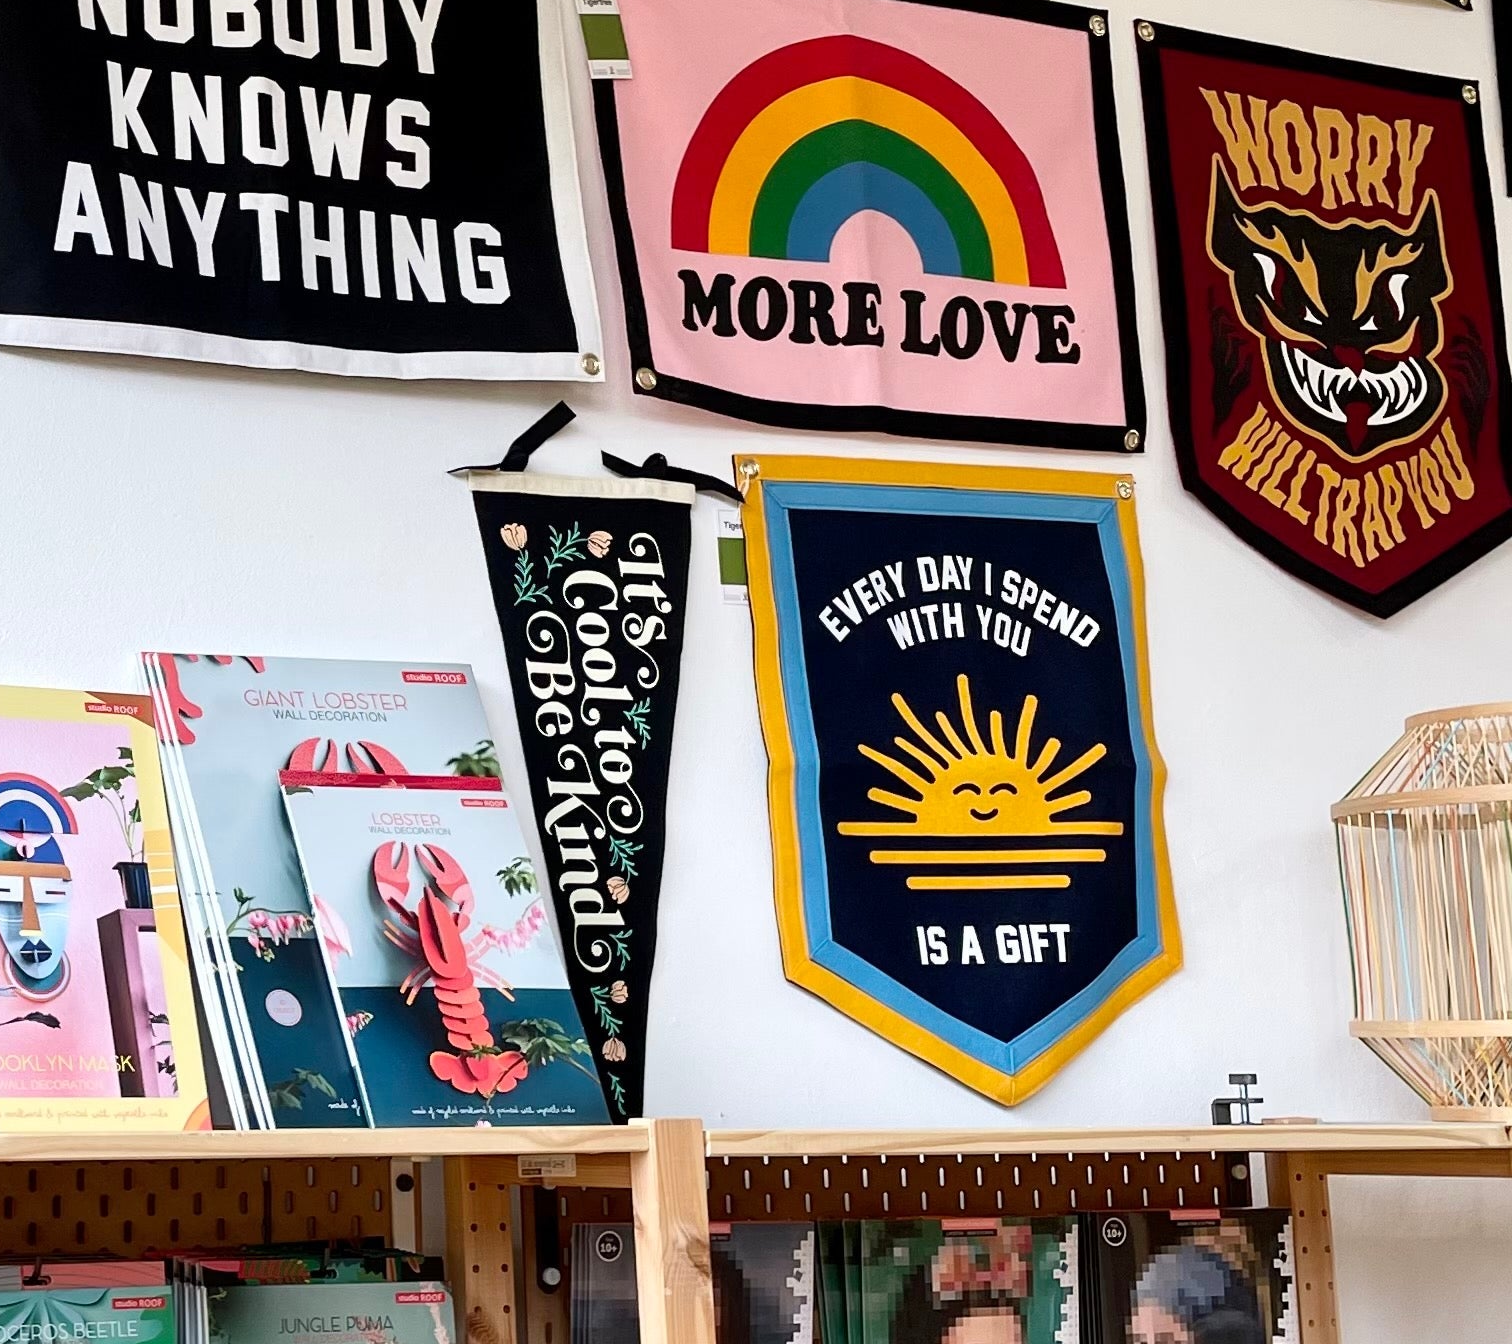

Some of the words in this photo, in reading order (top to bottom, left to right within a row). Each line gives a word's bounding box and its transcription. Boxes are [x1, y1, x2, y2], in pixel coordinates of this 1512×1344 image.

[106, 59, 431, 190] KNOWS
[1198, 87, 1434, 216] WORRY
[53, 160, 511, 304] ANYTHING
[677, 269, 884, 348] MORE
[899, 288, 1081, 365] LOVE
[1217, 401, 1311, 518] WILL
[1313, 459, 1407, 568] TRAP
[1399, 416, 1475, 530] YOU
[617, 532, 673, 690] It's
[818, 561, 906, 643] EVERY
[916, 555, 973, 592] DAY
[985, 562, 992, 596] I
[1000, 569, 1100, 647] SPEND
[887, 602, 965, 650] WITH
[976, 604, 1032, 657] YOU
[562, 569, 634, 727] Cool
[406, 673, 433, 682] studio
[434, 674, 464, 683] ROOF
[525, 610, 576, 737] Be
[88, 704, 113, 713] studio
[114, 705, 140, 715] ROOF
[244, 689, 305, 707] GIANT
[313, 692, 408, 711] LOBSTER
[272, 710, 307, 721] WALL
[308, 710, 388, 722] DECORATION
[593, 724, 644, 834] to
[371, 813, 441, 826] LOBSTER
[368, 826, 395, 834] WALL
[396, 826, 452, 836] DECORATION
[544, 743, 628, 974] Kind
[916, 925, 948, 966] IS
[960, 926, 985, 965] A
[995, 923, 1071, 965] GIFT
[79, 1055, 136, 1073] MASK
[31, 1079, 104, 1091] DECORATION
[1106, 1229, 1122, 1238] 10+
[600, 1243, 617, 1253] 10+
[139, 1299, 163, 1307] ROOF
[420, 1293, 443, 1302] ROOF
[74, 1320, 138, 1339] BEETLE
[279, 1316, 340, 1335] JUNGLE
[346, 1315, 394, 1332] PUMA
